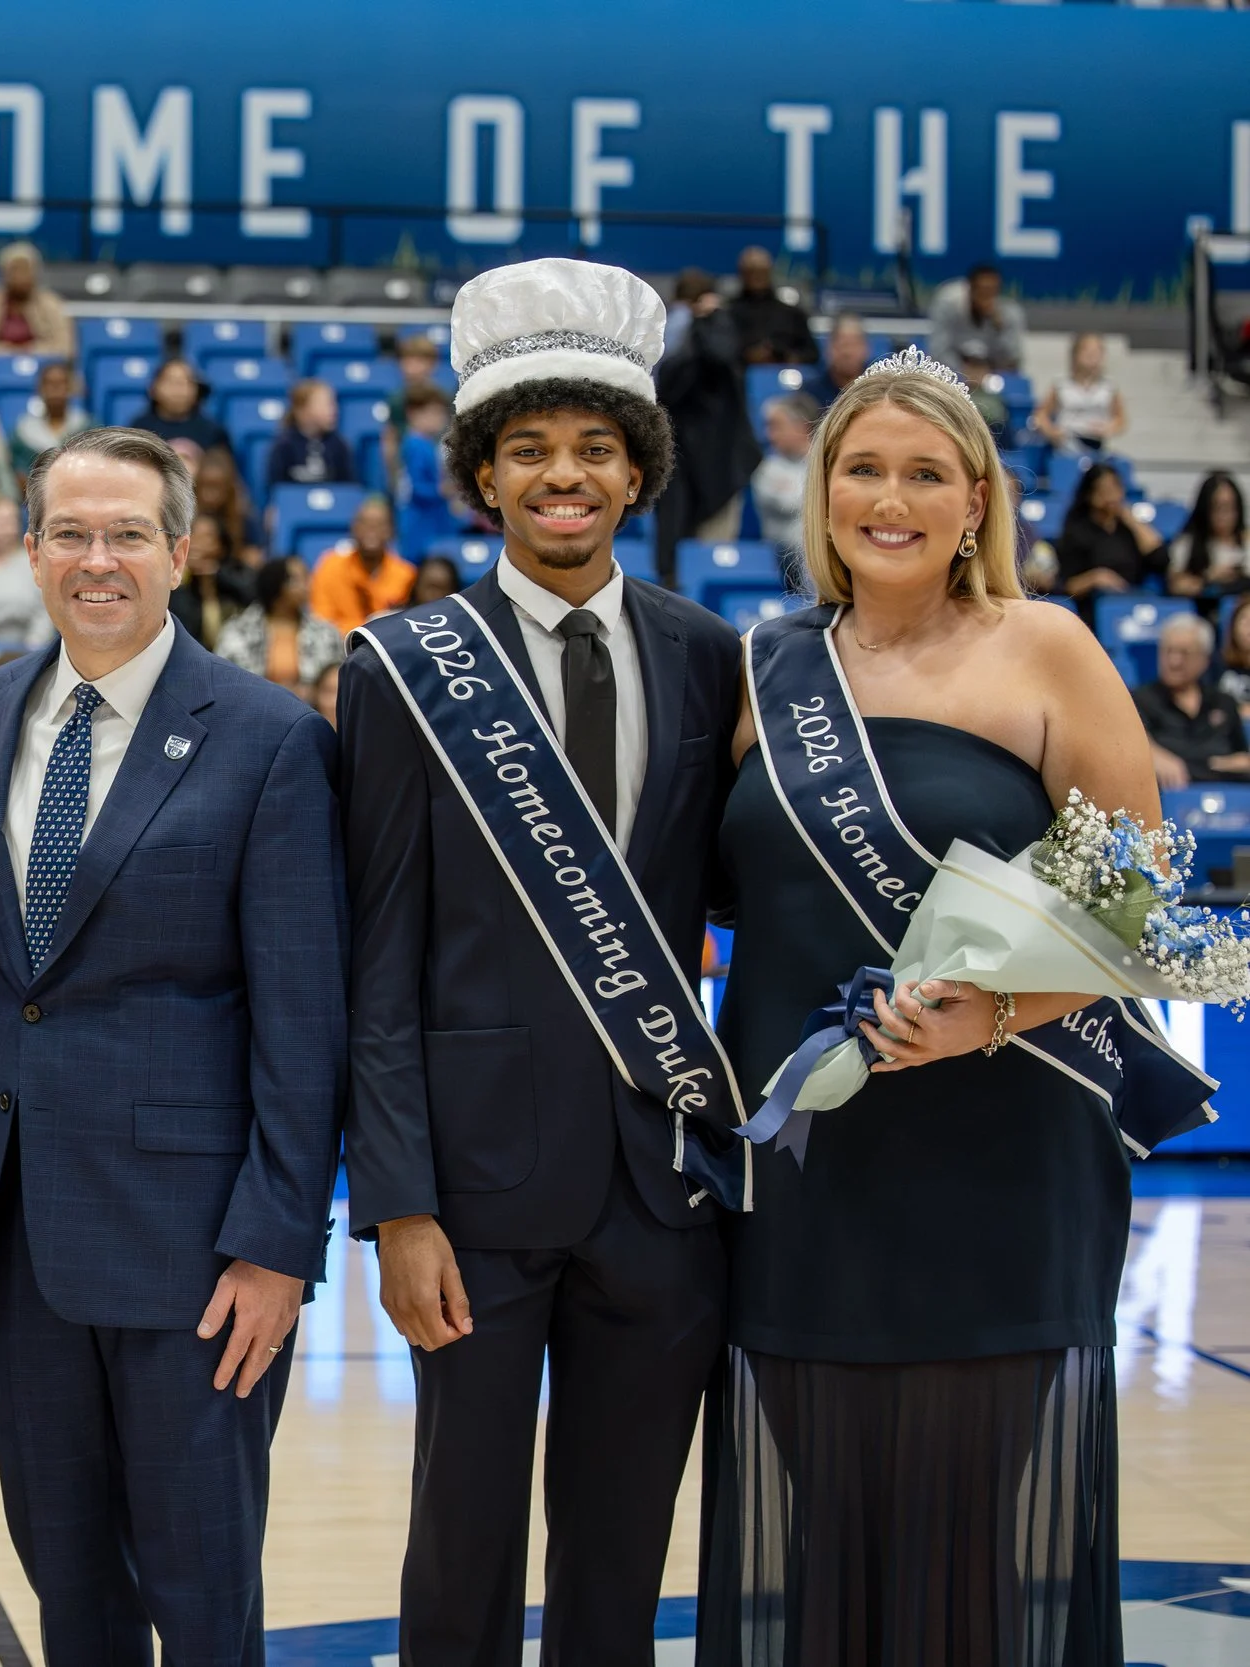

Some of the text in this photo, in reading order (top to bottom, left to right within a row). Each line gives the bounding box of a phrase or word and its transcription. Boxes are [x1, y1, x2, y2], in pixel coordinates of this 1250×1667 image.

[448, 96, 640, 246] OF
[767, 104, 1061, 257] THE
[403, 613, 714, 1114] 2026 Homecoming Duke
[788, 696, 923, 915] 2026 Homec
